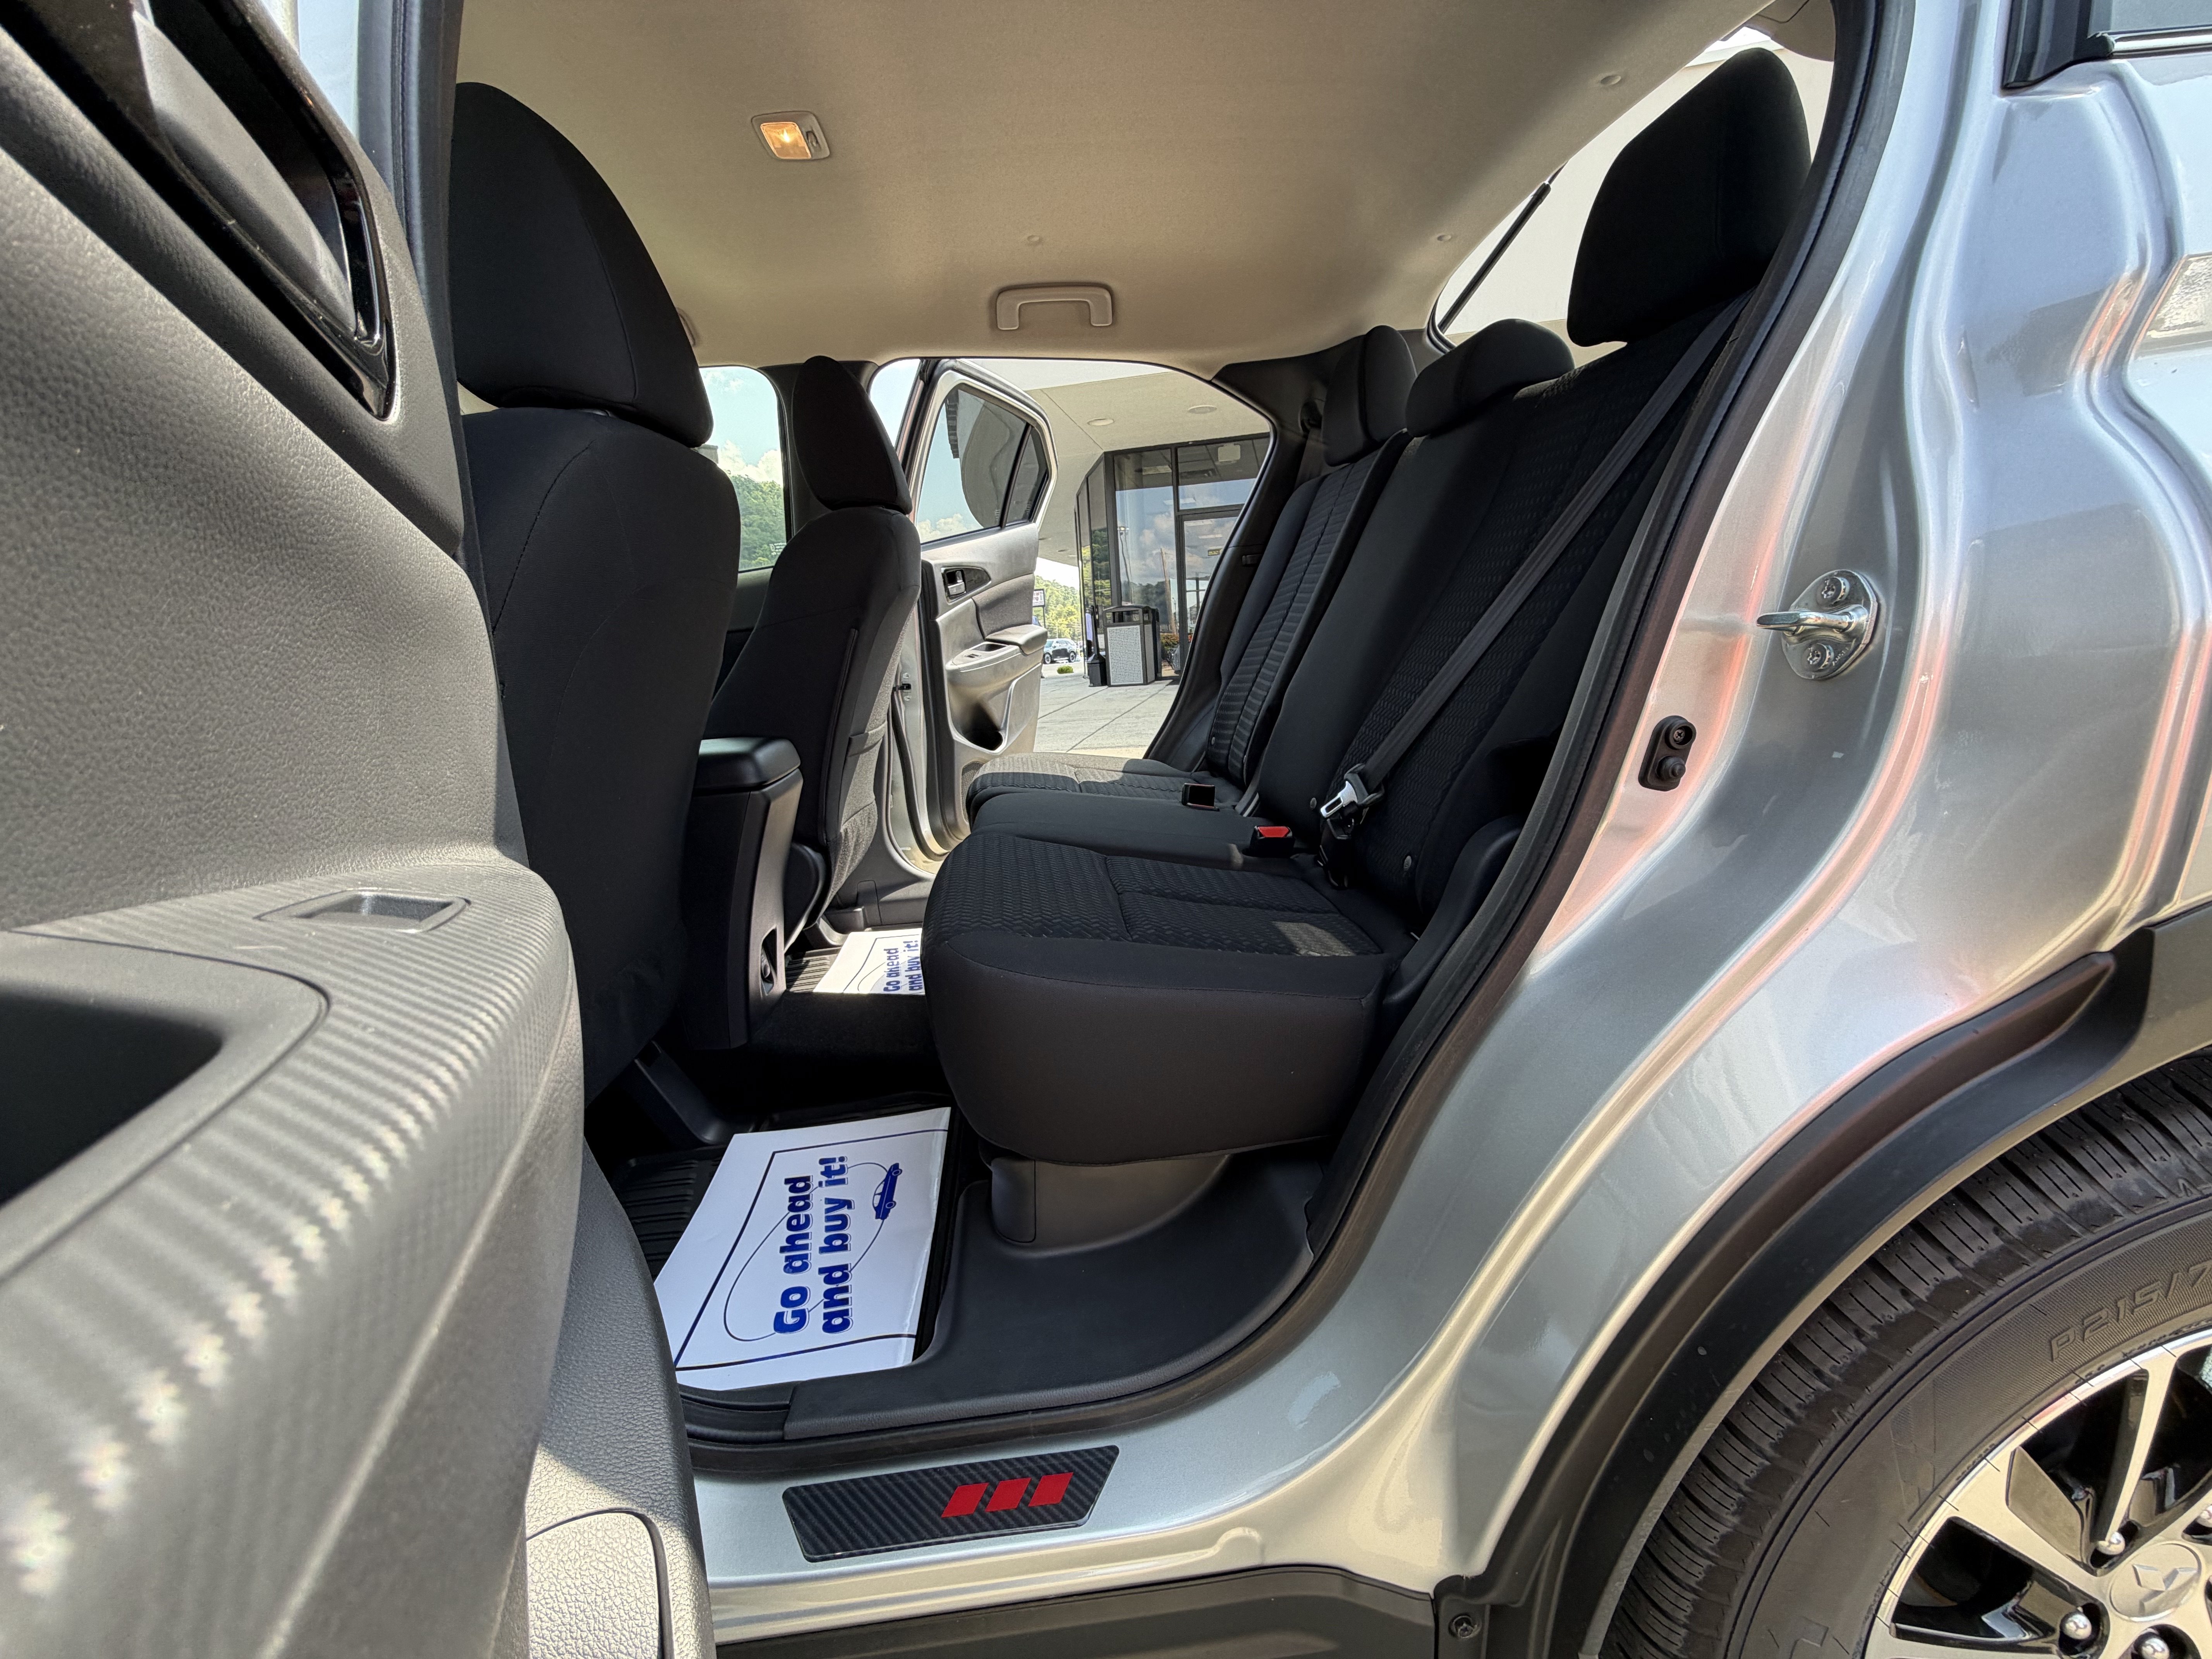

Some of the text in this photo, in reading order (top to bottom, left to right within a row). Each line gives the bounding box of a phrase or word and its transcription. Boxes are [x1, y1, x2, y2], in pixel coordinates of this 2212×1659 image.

[903, 940, 919, 952] it!
[883, 948, 900, 992] Go ahead
[905, 974, 923, 991] and
[773, 1175, 813, 1334] Go ahead
[818, 1156, 855, 1334] and buy it!
